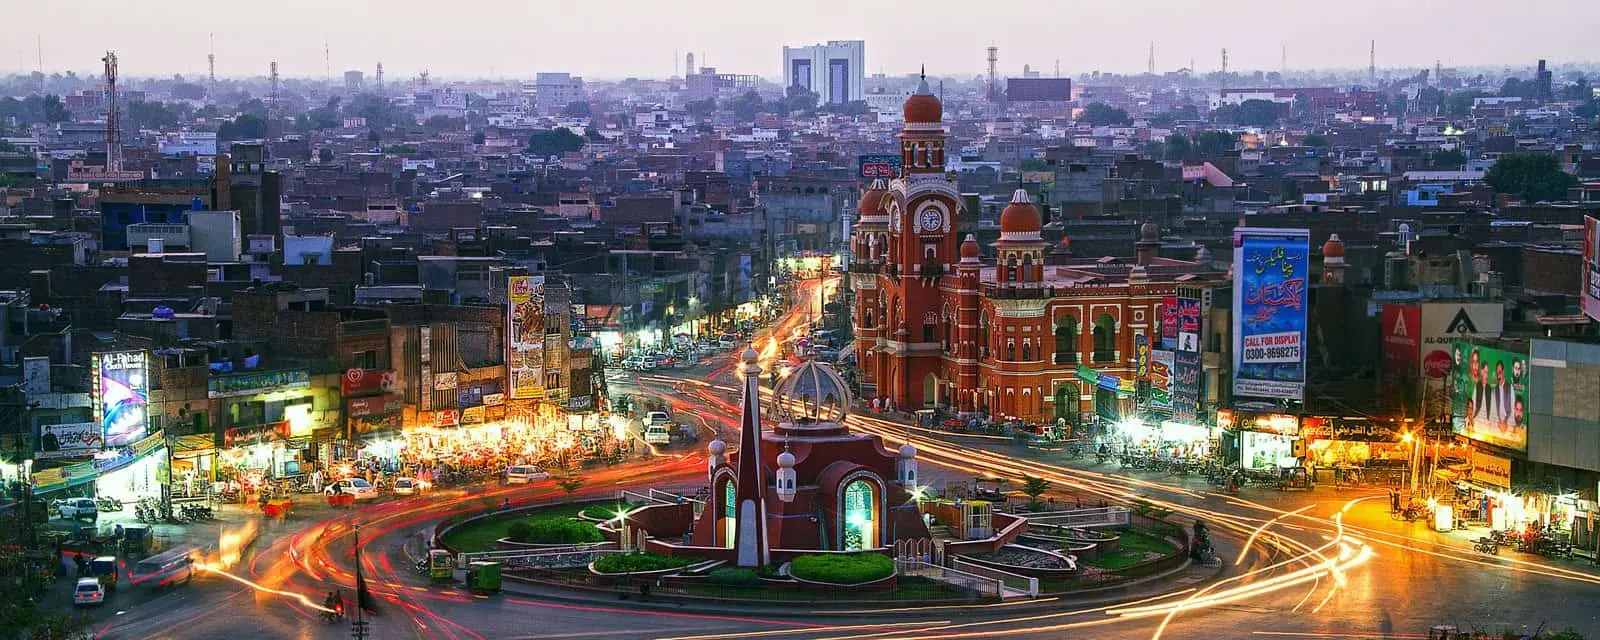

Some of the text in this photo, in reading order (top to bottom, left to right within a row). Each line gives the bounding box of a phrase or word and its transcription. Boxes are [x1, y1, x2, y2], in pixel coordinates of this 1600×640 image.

[1245, 334, 1299, 347] CALL FOR DISPLAY
[104, 352, 144, 363] Al-Fahad
